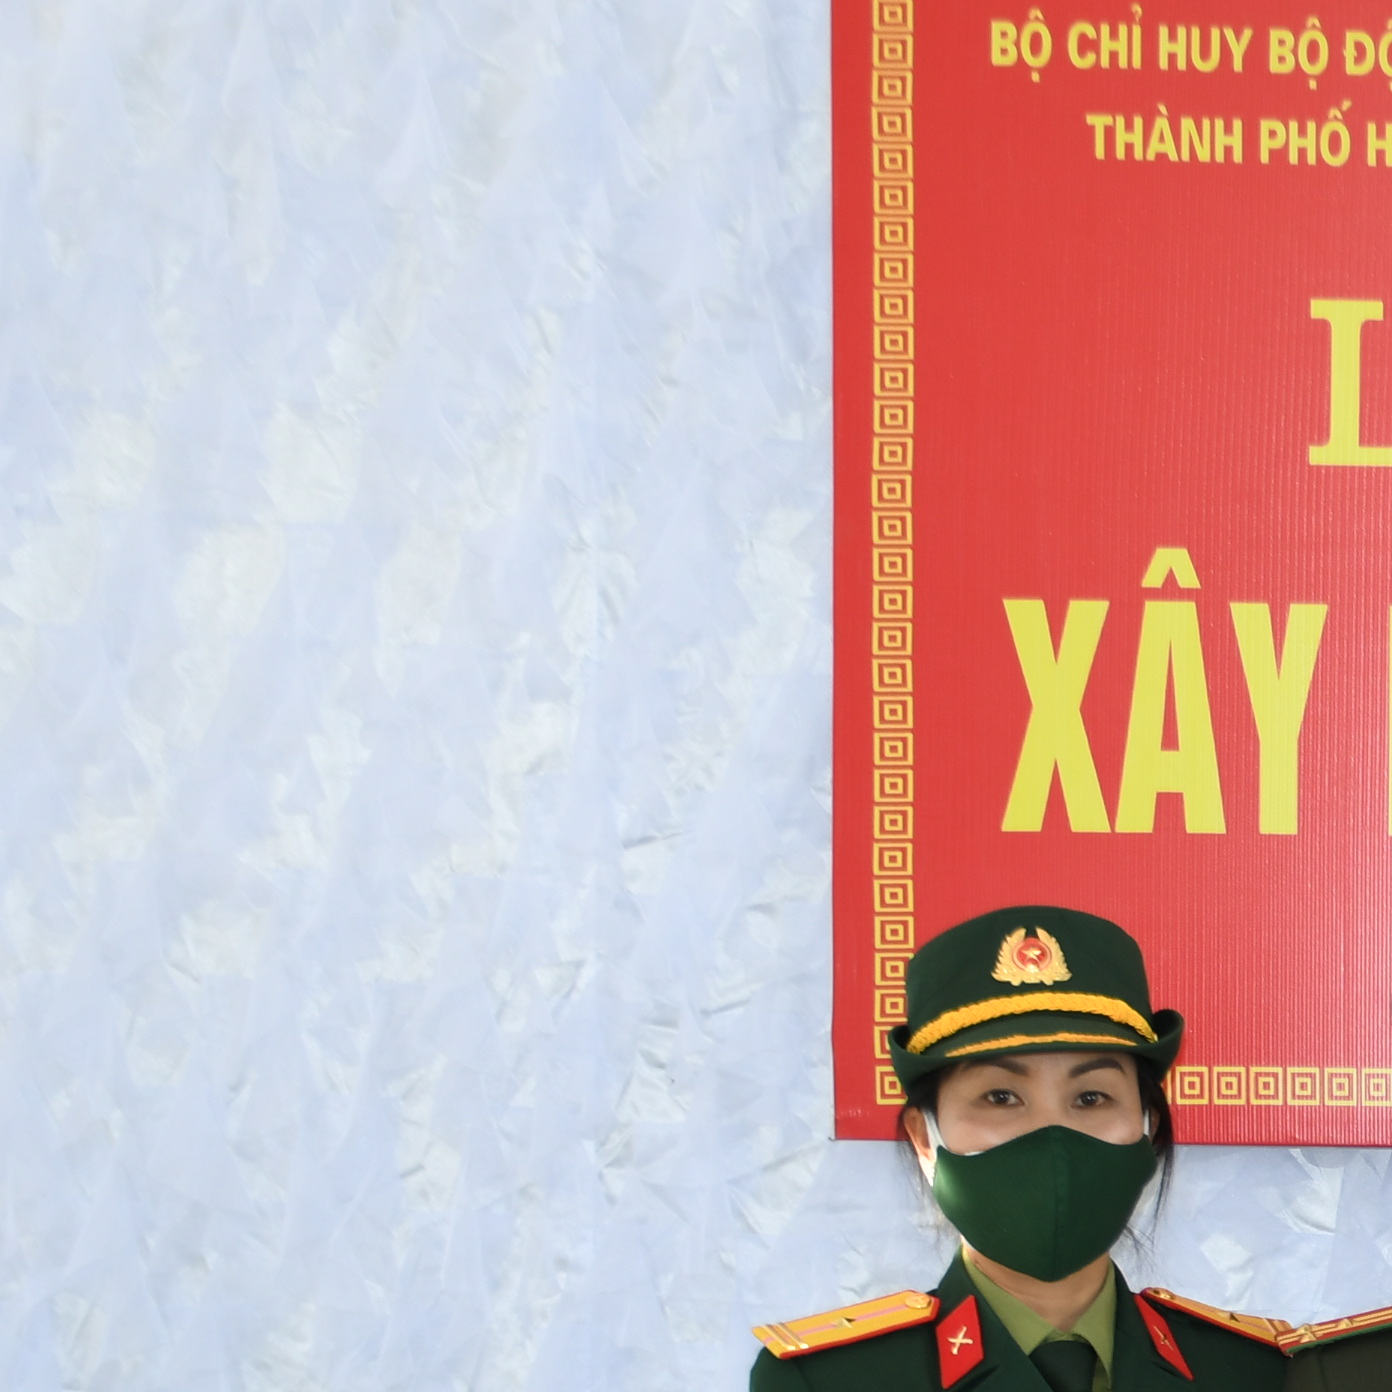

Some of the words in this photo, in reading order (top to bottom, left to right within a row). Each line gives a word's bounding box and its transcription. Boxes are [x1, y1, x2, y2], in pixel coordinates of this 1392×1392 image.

[991, 9, 1052, 83] BỘ
[1068, 4, 1142, 70] CHỈ
[1159, 25, 1252, 74] HUY
[1269, 17, 1328, 89] BỘ
[1086, 104, 1242, 164] THÀNH
[1260, 100, 1351, 168] PHỐ
[1001, 547, 1329, 835] XÂY
